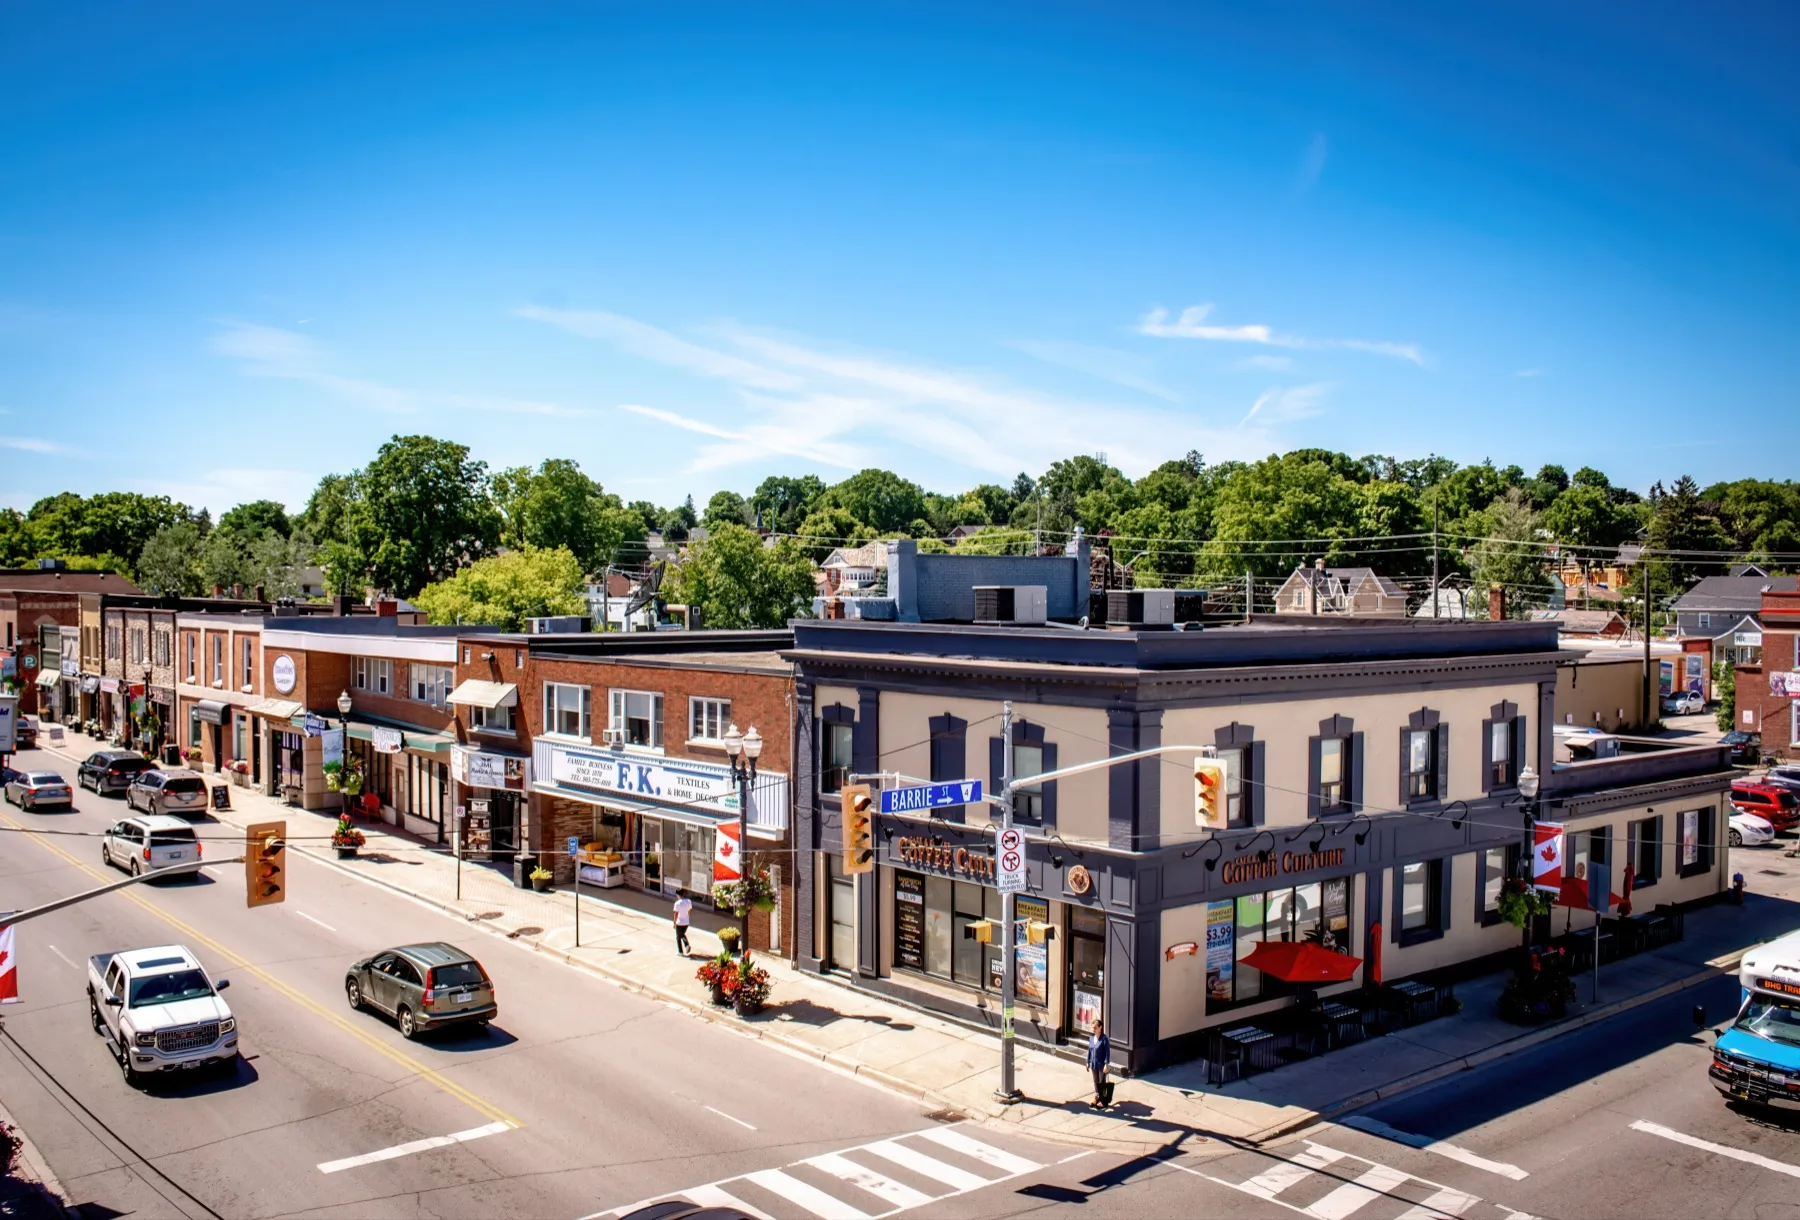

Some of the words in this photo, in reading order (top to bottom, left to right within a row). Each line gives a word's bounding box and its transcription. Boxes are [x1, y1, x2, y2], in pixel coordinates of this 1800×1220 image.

[567, 757, 586, 767] FAMILY
[588, 760, 613, 771] BUSINESS
[576, 767, 591, 776] SINCE
[616, 761, 661, 797] F.K.
[676, 776, 710, 790] TEXTILES
[667, 787, 672, 796] &
[673, 788, 692, 800] HOME
[695, 792, 719, 805] DECOR
[891, 787, 933, 811] BARRIE
[942, 786, 949, 797] ST
[899, 836, 952, 871] COFFEE
[1222, 861, 1278, 885] COFFEE
[1283, 848, 1346, 873] CULTURE
[1017, 903, 1046, 914] BREAKFAST
[1206, 926, 1232, 942] $3.99
